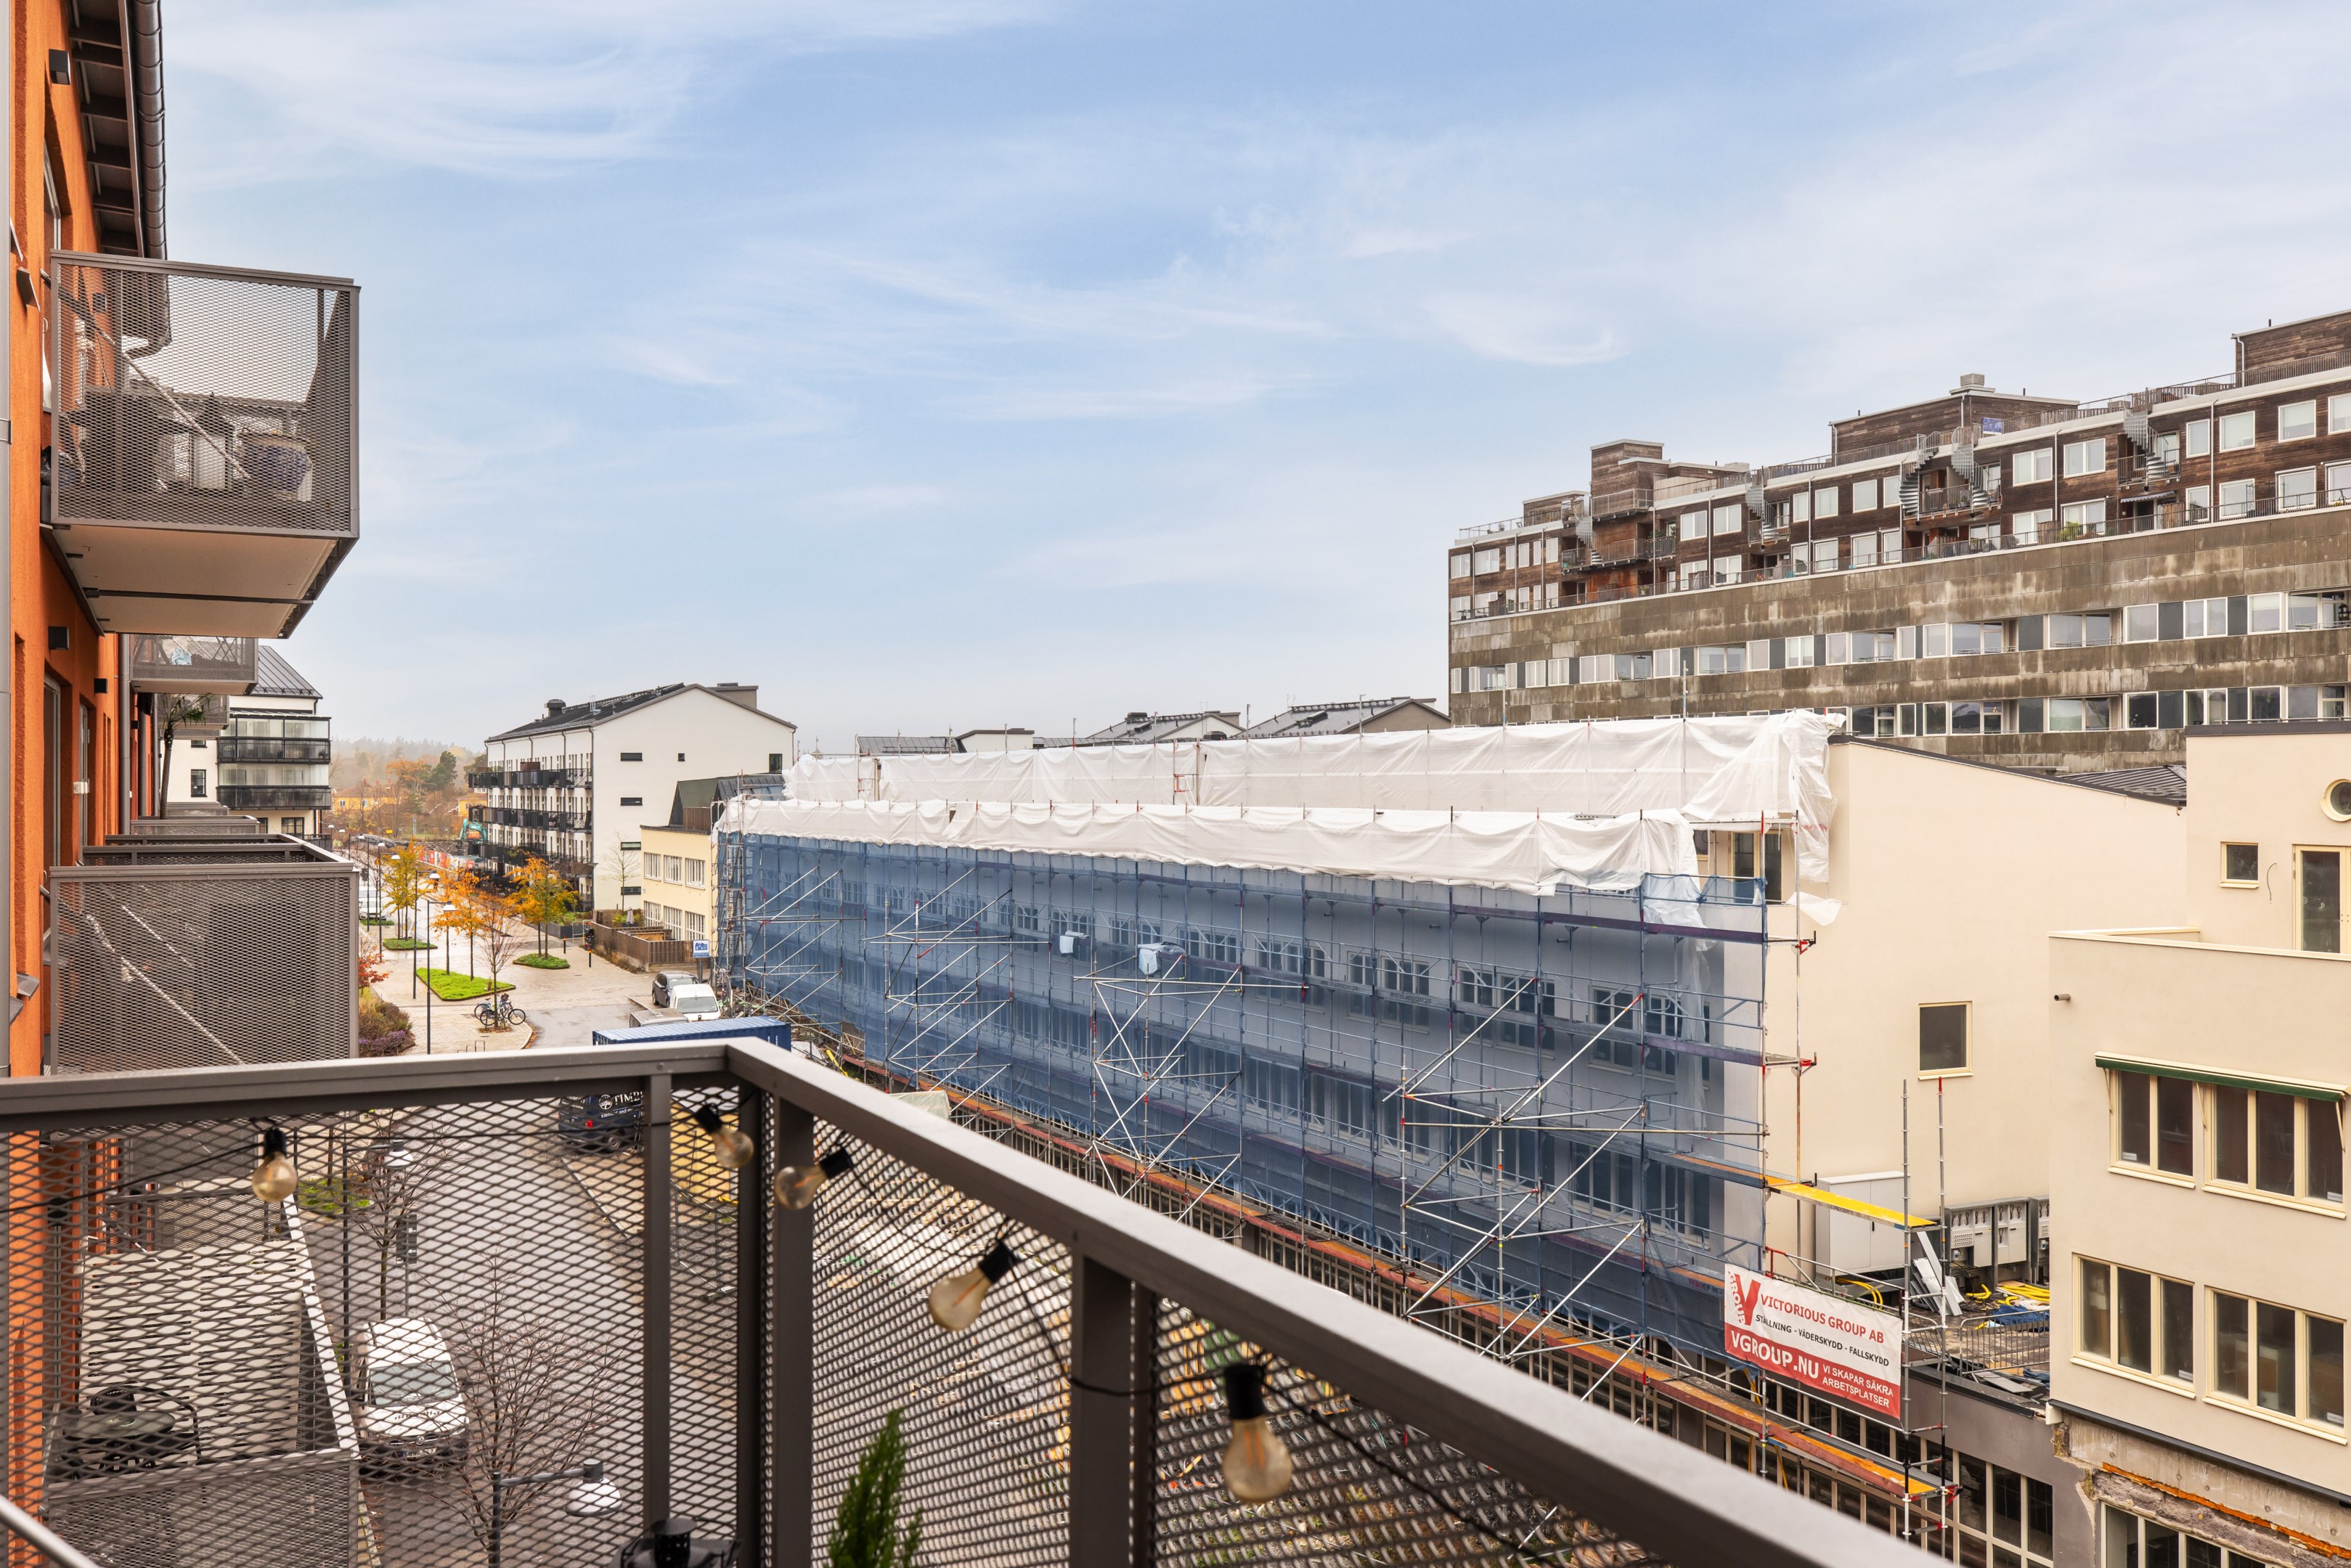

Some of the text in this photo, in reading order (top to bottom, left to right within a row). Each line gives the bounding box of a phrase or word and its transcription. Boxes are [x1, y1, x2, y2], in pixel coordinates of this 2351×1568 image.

[1756, 1315, 1792, 1333] STÄLLNING
[1798, 1328, 1843, 1350] VÄDERSKYDD
[1849, 1346, 1889, 1366] FALLSKYDD
[1761, 1294, 1884, 1344] VICTORIOUS GROUP AB
[1731, 1330, 1819, 1379] VGROUP.NU
[1822, 1364, 1894, 1397] VI SKAPAR SÄKRA
[1822, 1376, 1889, 1408] ARBETSPLATSER
